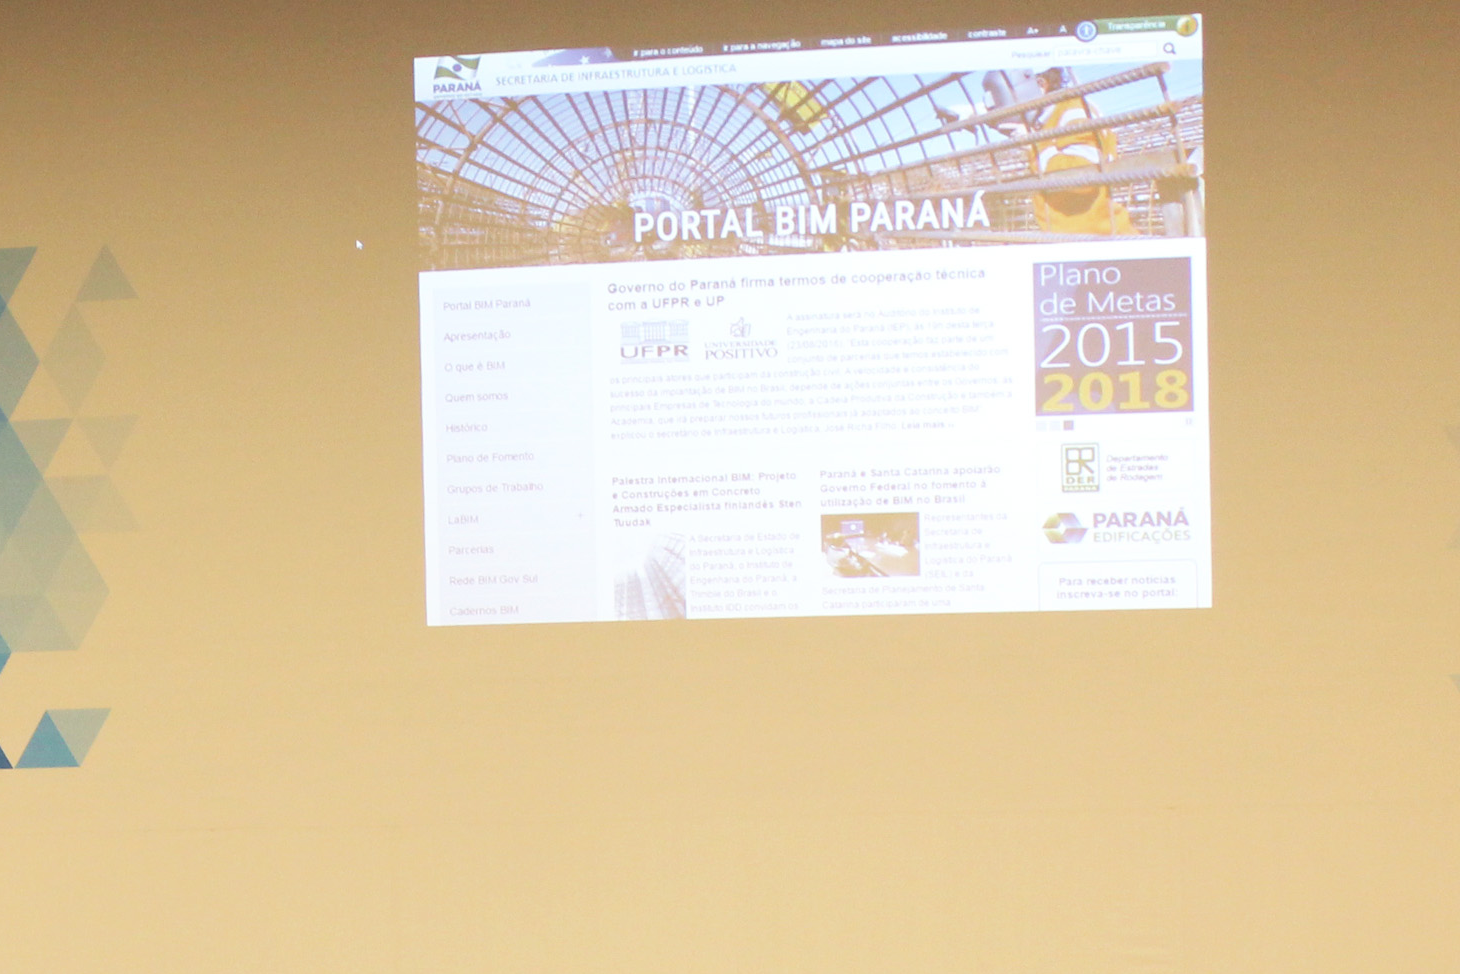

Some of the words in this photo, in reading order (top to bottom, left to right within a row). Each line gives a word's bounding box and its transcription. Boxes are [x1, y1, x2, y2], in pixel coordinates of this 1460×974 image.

[967, 28, 1007, 38] contraste
[1058, 24, 1067, 33] A
[495, 73, 558, 86] SECRETARIA
[560, 72, 574, 82] DE
[577, 66, 670, 81] INFRAESTRUTURA
[672, 66, 677, 76] E
[681, 63, 736, 75] LOGÍSTICA
[432, 79, 482, 93] PARANÁ
[633, 206, 764, 243] PORTAL
[774, 202, 837, 236] BIM
[850, 189, 990, 233] PARANÁ
[606, 280, 665, 294] Governo
[689, 277, 736, 290] Paraná
[740, 275, 775, 288] firma
[778, 274, 826, 287] termos
[830, 273, 847, 284] de
[850, 270, 931, 286] cooperação
[935, 268, 985, 280] técnica
[1040, 261, 1121, 287] Plano
[442, 300, 472, 311] Portal
[473, 299, 493, 310] BIM
[495, 297, 531, 309] Paraná
[607, 301, 636, 311] com
[639, 300, 648, 310] a
[651, 296, 689, 309] UFPR
[693, 298, 701, 307] e
[705, 295, 725, 307] UP
[1039, 291, 1076, 315] de
[1087, 288, 1176, 314] Metas
[442, 328, 511, 343] Apresentação
[620, 344, 688, 358] UFPR
[1038, 319, 1183, 369] 2015
[705, 347, 778, 360] POSITIVO
[443, 362, 453, 372] O
[454, 363, 474, 373] que
[476, 361, 484, 371] é
[485, 360, 506, 370] BIM
[444, 392, 475, 403] Quem
[476, 392, 509, 401] somos
[1039, 368, 1188, 413] 2018
[445, 422, 488, 433] Histórico
[446, 453, 474, 463] Plano
[475, 453, 489, 462] de
[491, 451, 535, 462] Fomento
[611, 475, 654, 486] Palestra
[657, 473, 728, 484] Internacional
[757, 470, 796, 483] Projeto
[819, 469, 857, 479] Paraná
[859, 470, 866, 478] e
[870, 467, 901, 477] Santa
[903, 466, 949, 476] Catarina
[952, 465, 1001, 476] apoiarão
[819, 483, 866, 493] Governo
[869, 481, 911, 491] Federal
[913, 482, 928, 490] no
[931, 480, 977, 489] fomento
[1064, 475, 1095, 485] DER
[446, 483, 483, 495] Grupos
[485, 483, 498, 493] de
[501, 481, 544, 492] Trabalho
[611, 492, 618, 500] e
[620, 488, 690, 501] Construções
[692, 489, 709, 497] em
[711, 486, 760, 497] Concreto
[612, 503, 653, 513] Armado
[656, 501, 721, 514] Especialista
[778, 499, 802, 508] Sten
[820, 497, 872, 509] utilização
[875, 497, 889, 505] de
[892, 495, 913, 505] BIM
[916, 496, 930, 504] no
[933, 493, 965, 504] Brasil
[447, 514, 479, 525] LaBIM
[1092, 506, 1189, 528] PARANÁ
[1092, 525, 1191, 546] EDIFICAÇÕES
[447, 544, 494, 555] Parcerias
[448, 575, 475, 586] Rede
[477, 575, 497, 585] BIM
[498, 574, 519, 584] Gov
[522, 573, 538, 583] Sul
[1058, 577, 1083, 586] Para
[1086, 576, 1128, 585] receber
[1130, 575, 1176, 585] notícias
[1056, 590, 1121, 599] inscreva-se
[1123, 589, 1138, 597] no
[448, 606, 497, 616] Cadernos
[499, 605, 519, 615] BIM
